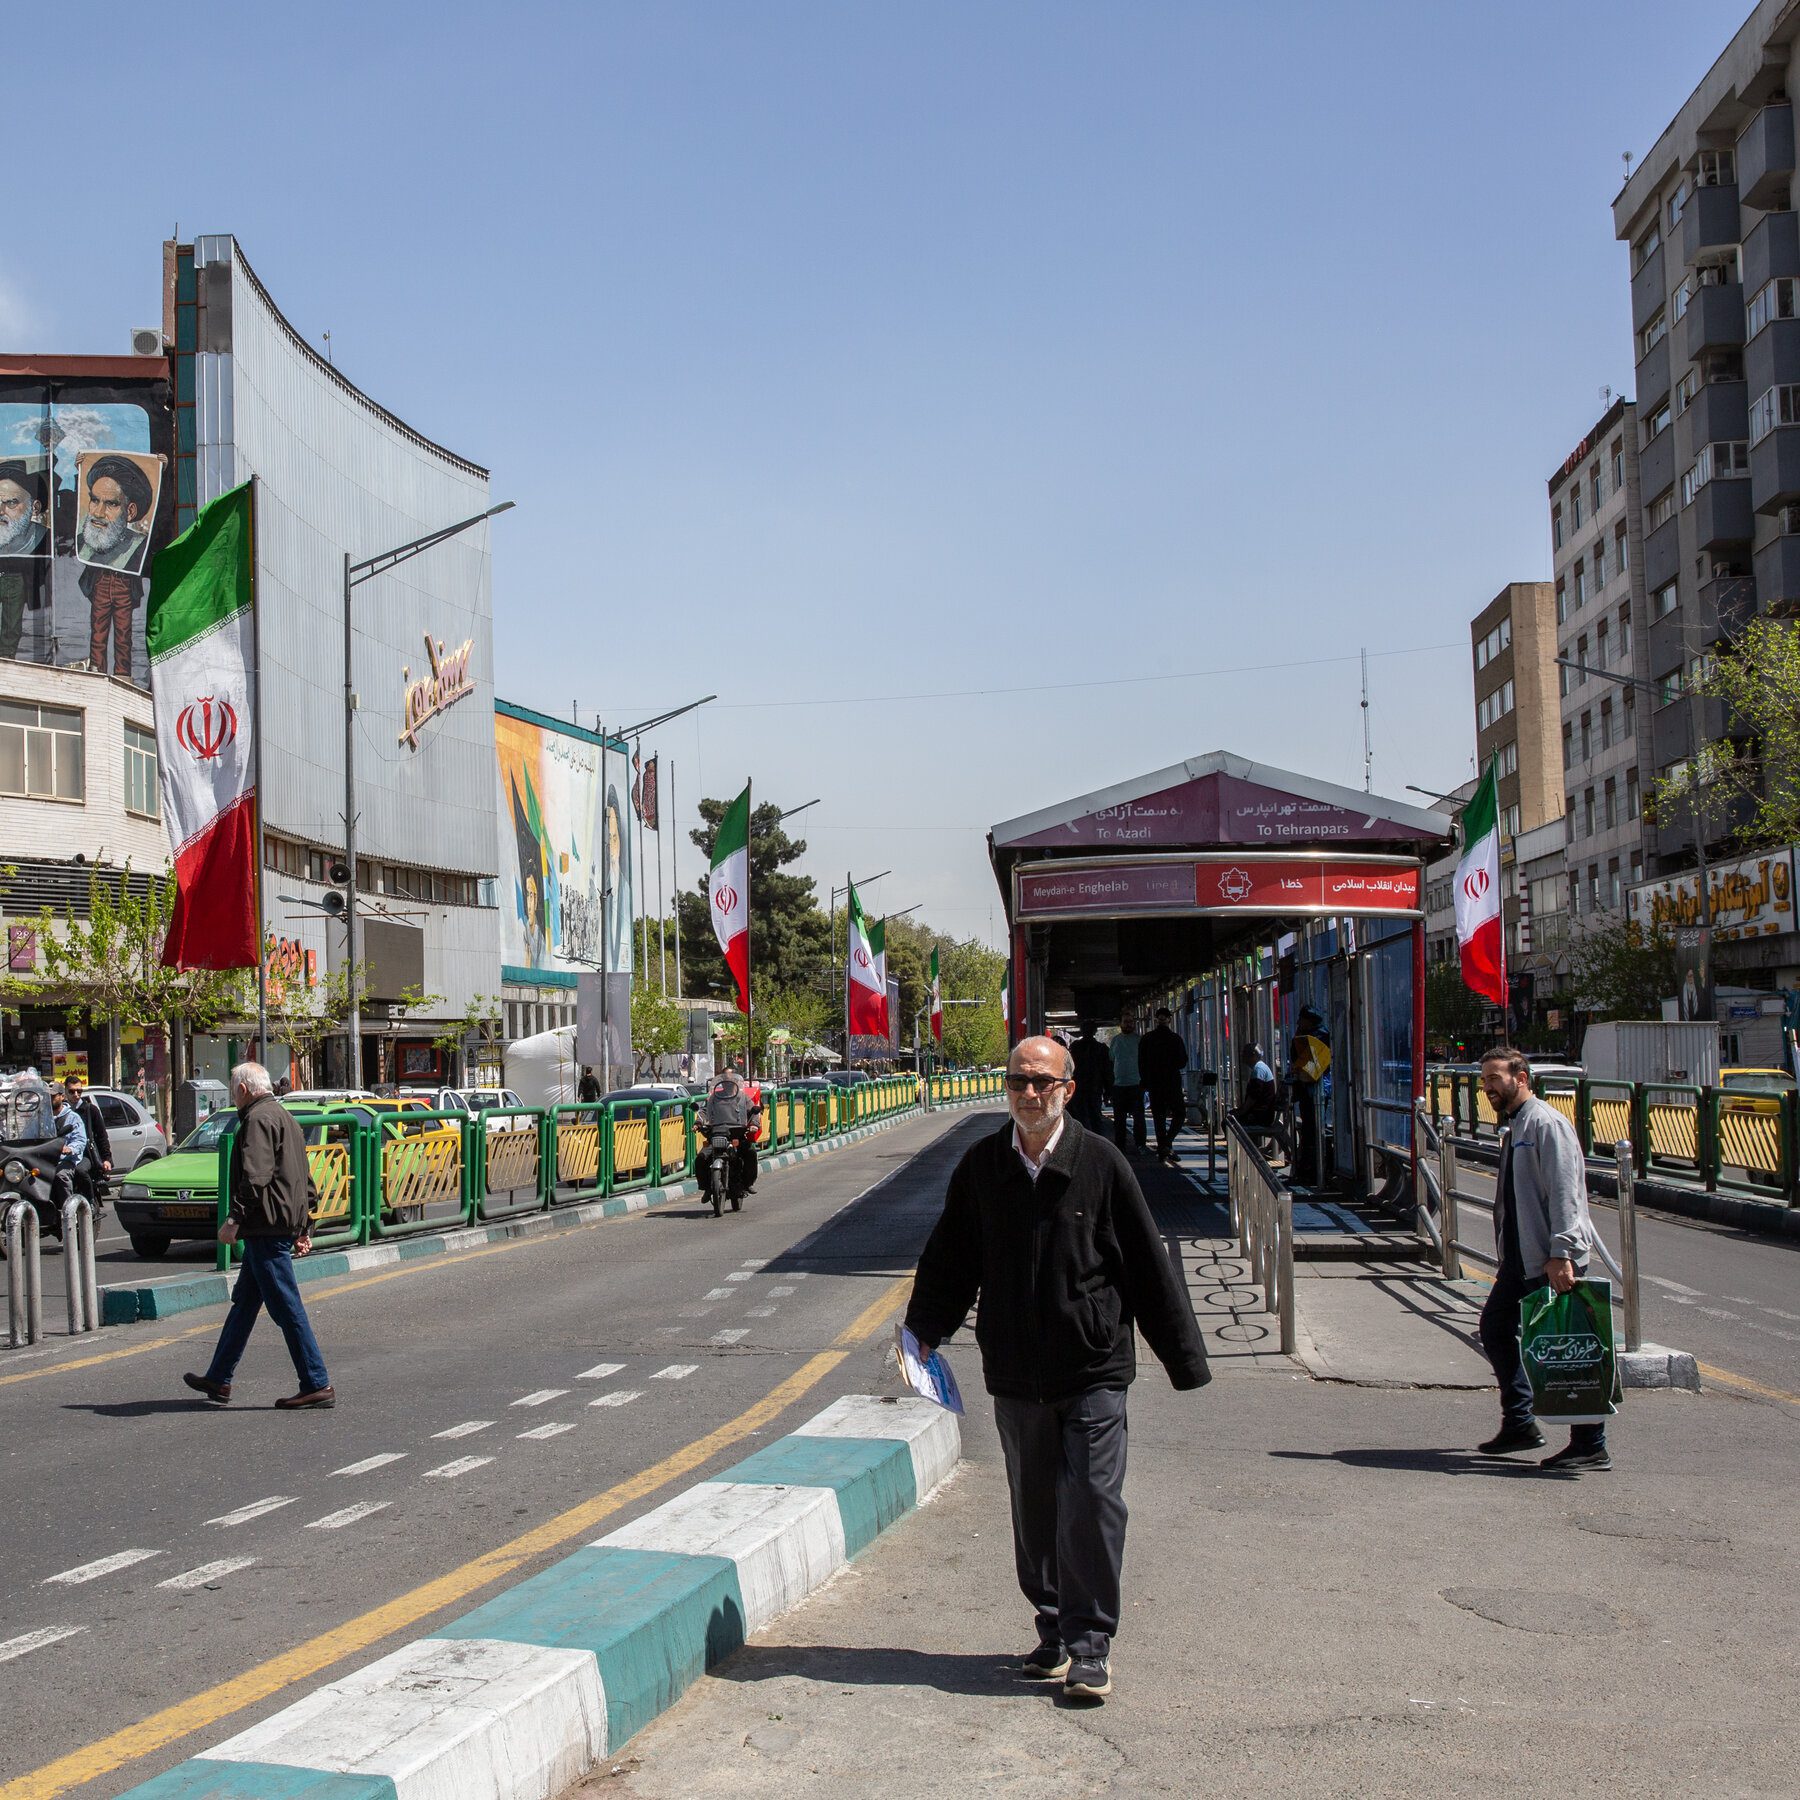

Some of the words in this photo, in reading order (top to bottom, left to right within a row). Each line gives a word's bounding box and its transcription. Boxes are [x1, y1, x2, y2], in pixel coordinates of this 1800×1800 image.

[1095, 803, 1133, 820] آزادی
[1133, 806, 1167, 816] سمت
[1236, 802, 1297, 818] تهرانپارس
[1299, 802, 1331, 812] سمت
[1096, 828, 1111, 839] To
[1116, 827, 1151, 839] Azadi
[1257, 824, 1272, 836] To
[1275, 823, 1349, 836] Tehranpars
[1033, 886, 1075, 897] Meydan-e
[1078, 881, 1129, 894] Enghelab
[1332, 879, 1365, 892] اسلامی
[1366, 880, 1392, 893] انقلاب
[1393, 881, 1416, 894] میدان
